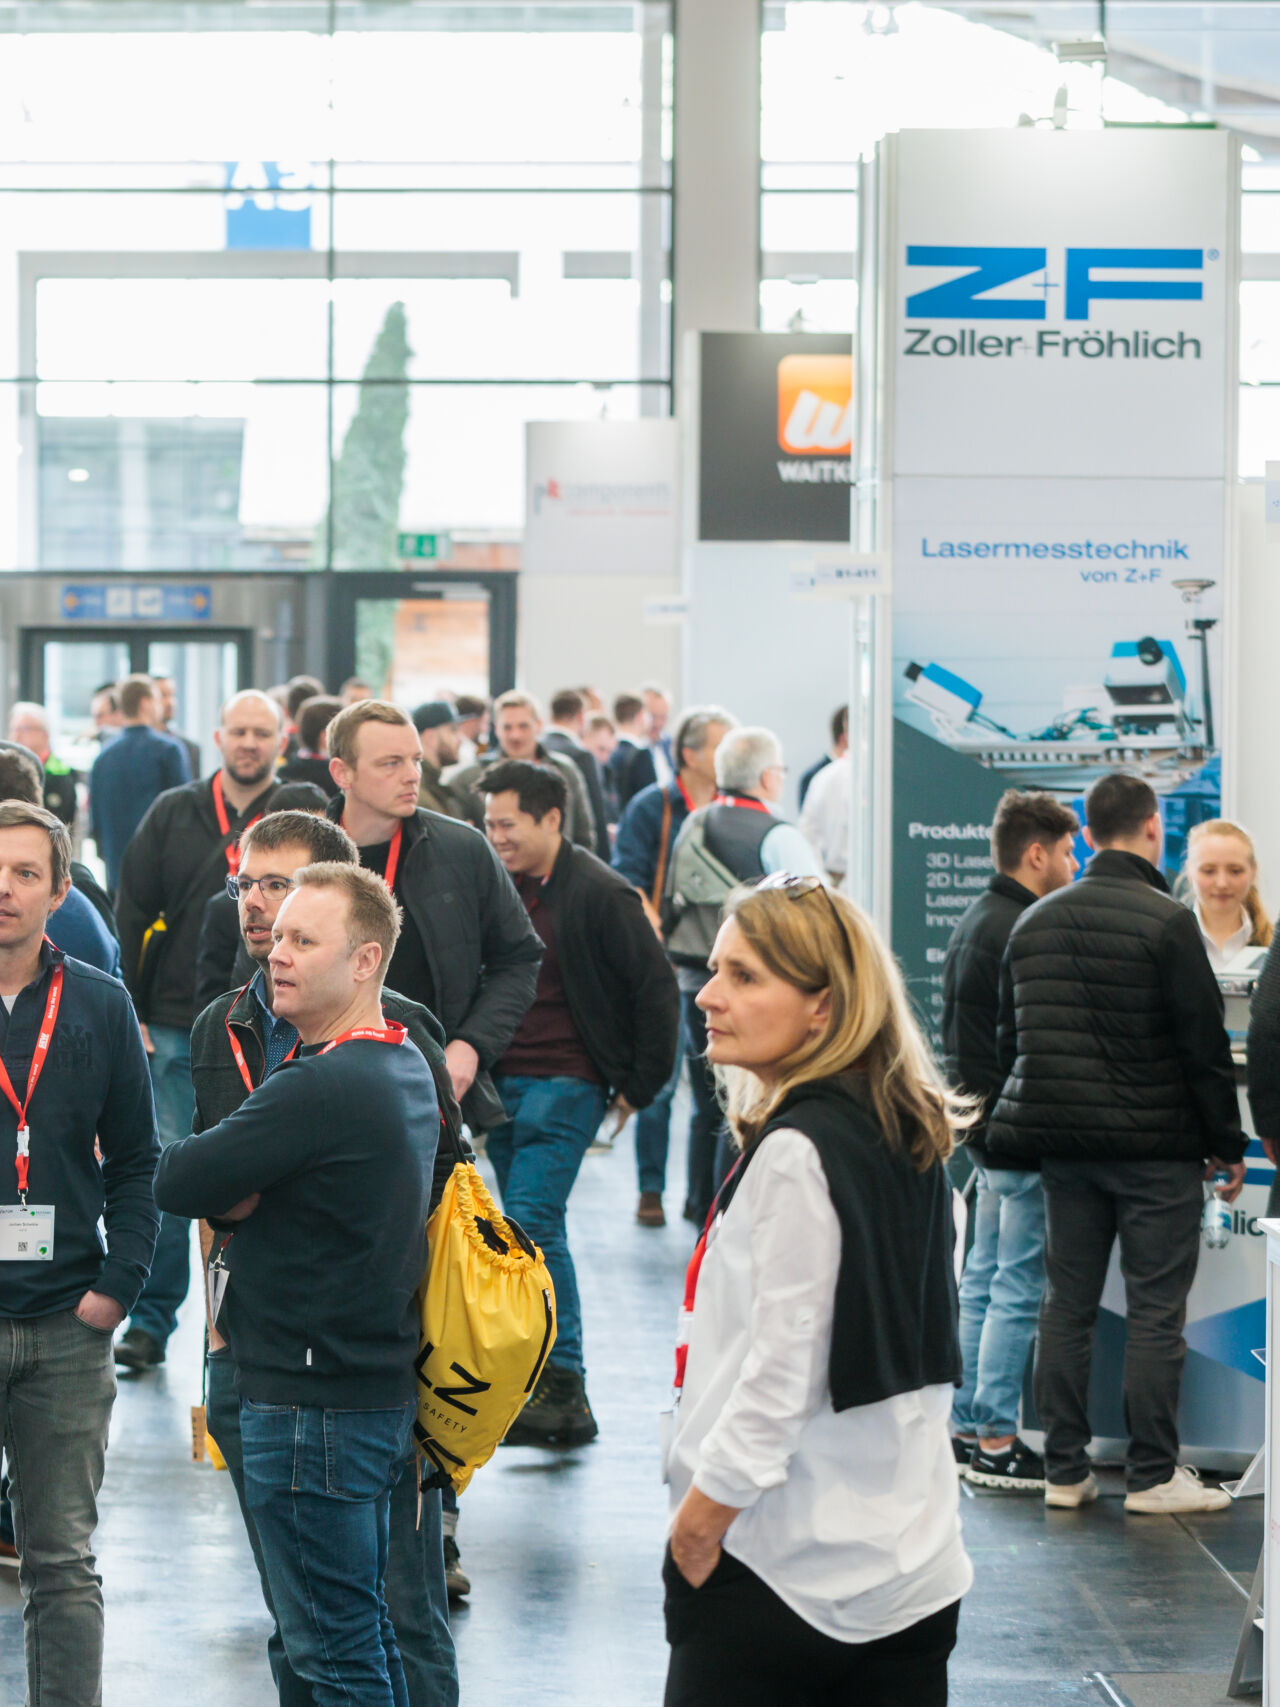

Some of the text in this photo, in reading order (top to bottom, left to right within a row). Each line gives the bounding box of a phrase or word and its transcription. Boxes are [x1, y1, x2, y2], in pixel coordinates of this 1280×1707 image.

[921, 538, 1190, 560] Lasermesstechnik
[1080, 568, 1161, 583] von Z+F
[925, 852, 993, 869] 3D Lase
[925, 871, 990, 889] 2D Lase
[423, 1402, 468, 1433] SAFETY
